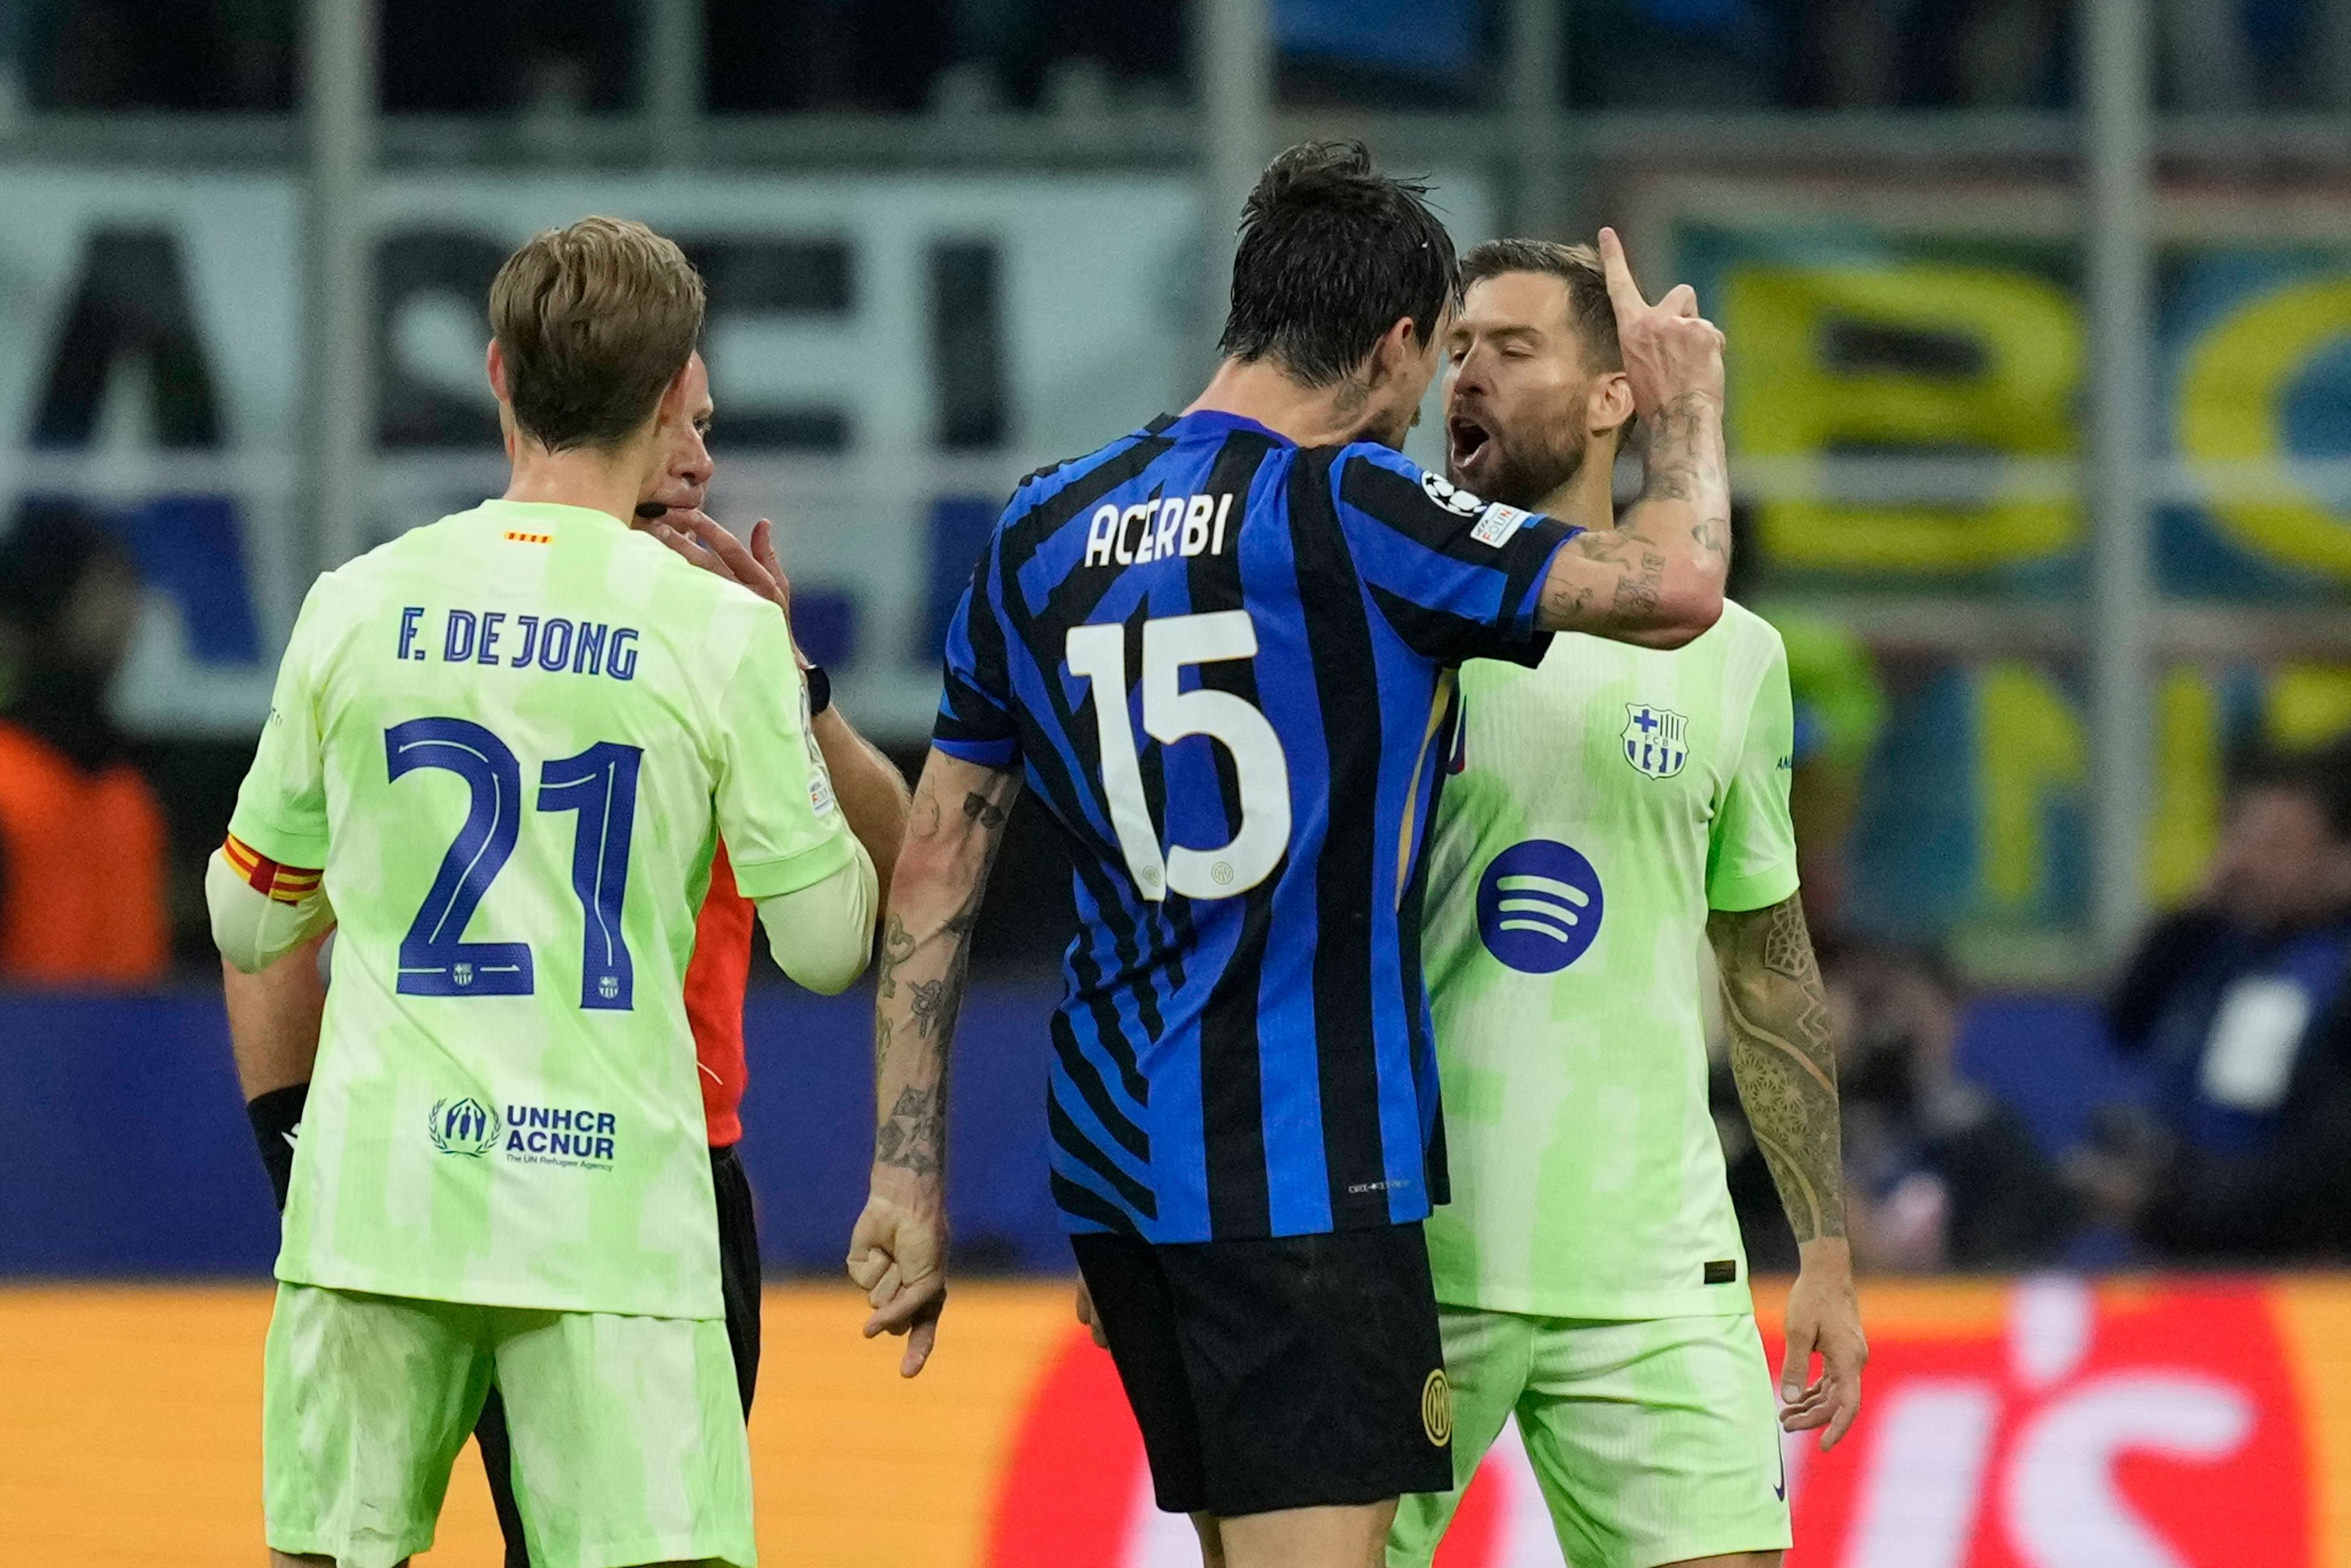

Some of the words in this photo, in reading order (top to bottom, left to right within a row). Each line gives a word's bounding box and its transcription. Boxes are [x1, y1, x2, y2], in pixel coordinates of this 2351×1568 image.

[1084, 492, 1234, 568] ACERBI
[397, 607, 426, 661] F.
[443, 609, 507, 666] DE
[511, 615, 639, 682] JONG
[1066, 609, 1292, 903] 15
[1645, 735, 1669, 747] FCB
[384, 716, 646, 1011] 21
[505, 1130, 615, 1160] ACNUR
[506, 1105, 616, 1135] UNHCR
[507, 1154, 521, 1162] The
[524, 1155, 538, 1164] UN
[540, 1156, 578, 1168] Refugee
[580, 1160, 614, 1172] Agency
